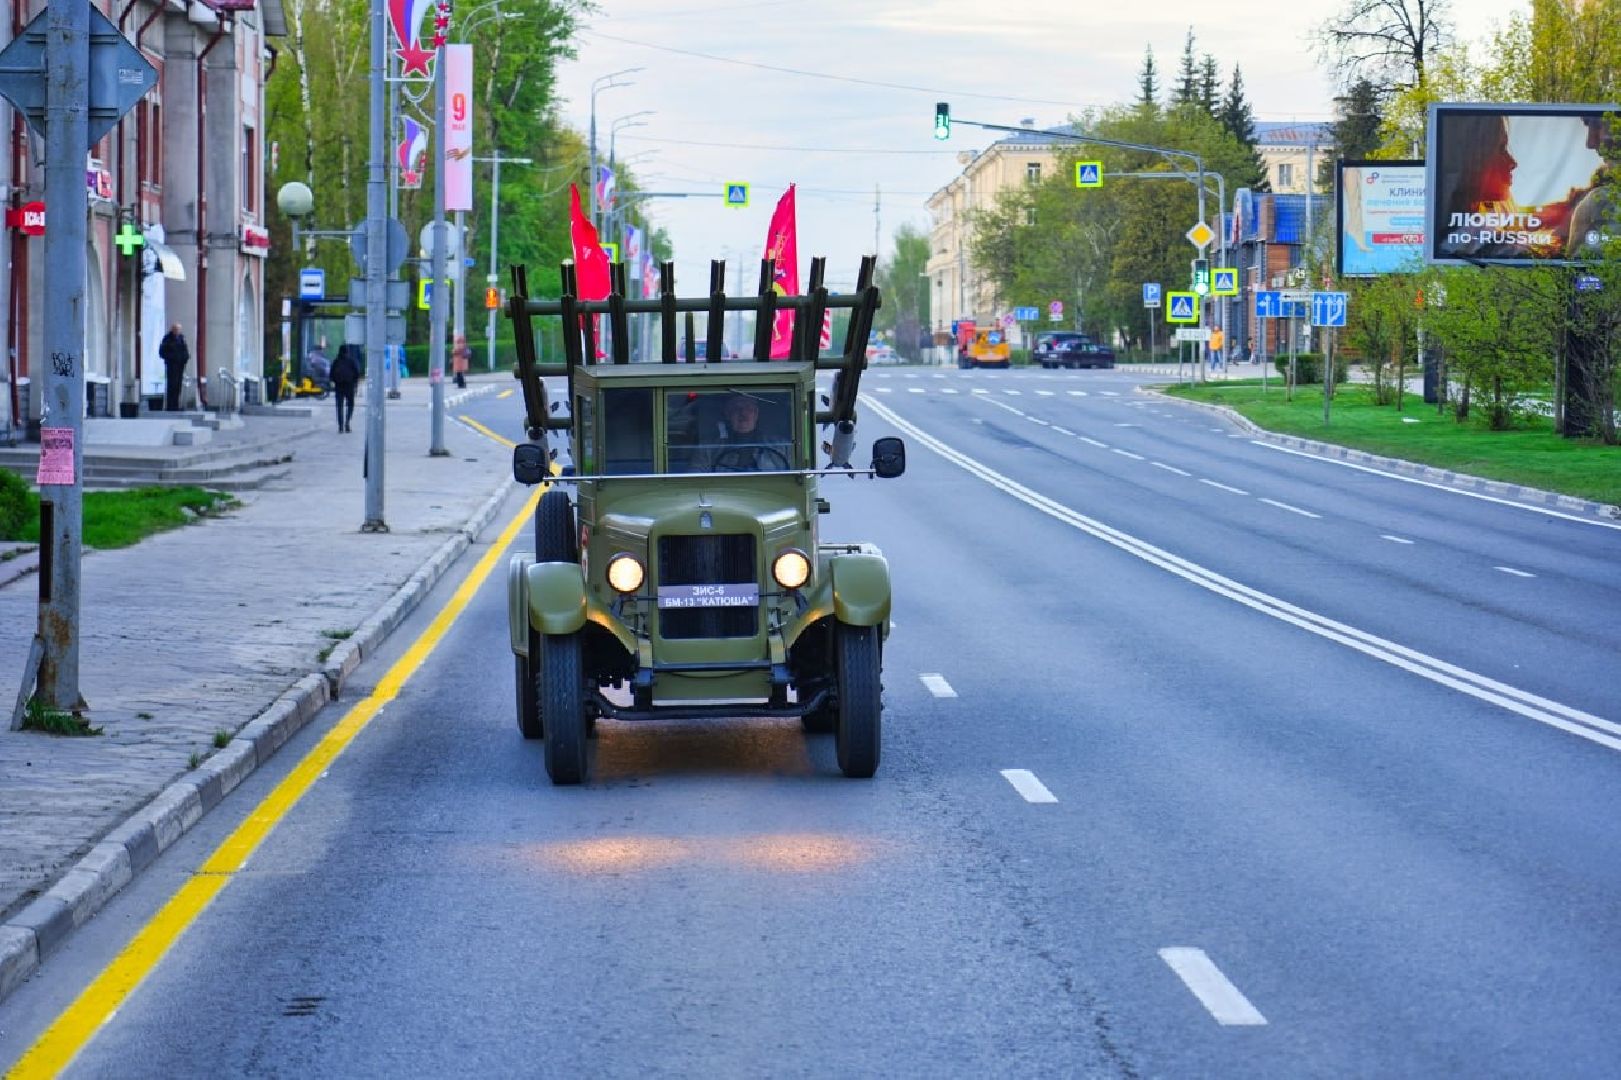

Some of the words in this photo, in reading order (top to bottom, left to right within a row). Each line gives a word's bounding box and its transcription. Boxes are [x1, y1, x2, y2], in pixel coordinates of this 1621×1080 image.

[453, 93, 465, 121] 9
[1448, 212, 1542, 227] ЛЮБИТЬ
[1448, 230, 1552, 244] по-RUSSки
[692, 586, 725, 596] ЗИС-6
[696, 596, 753, 606] "КАТЮША"
